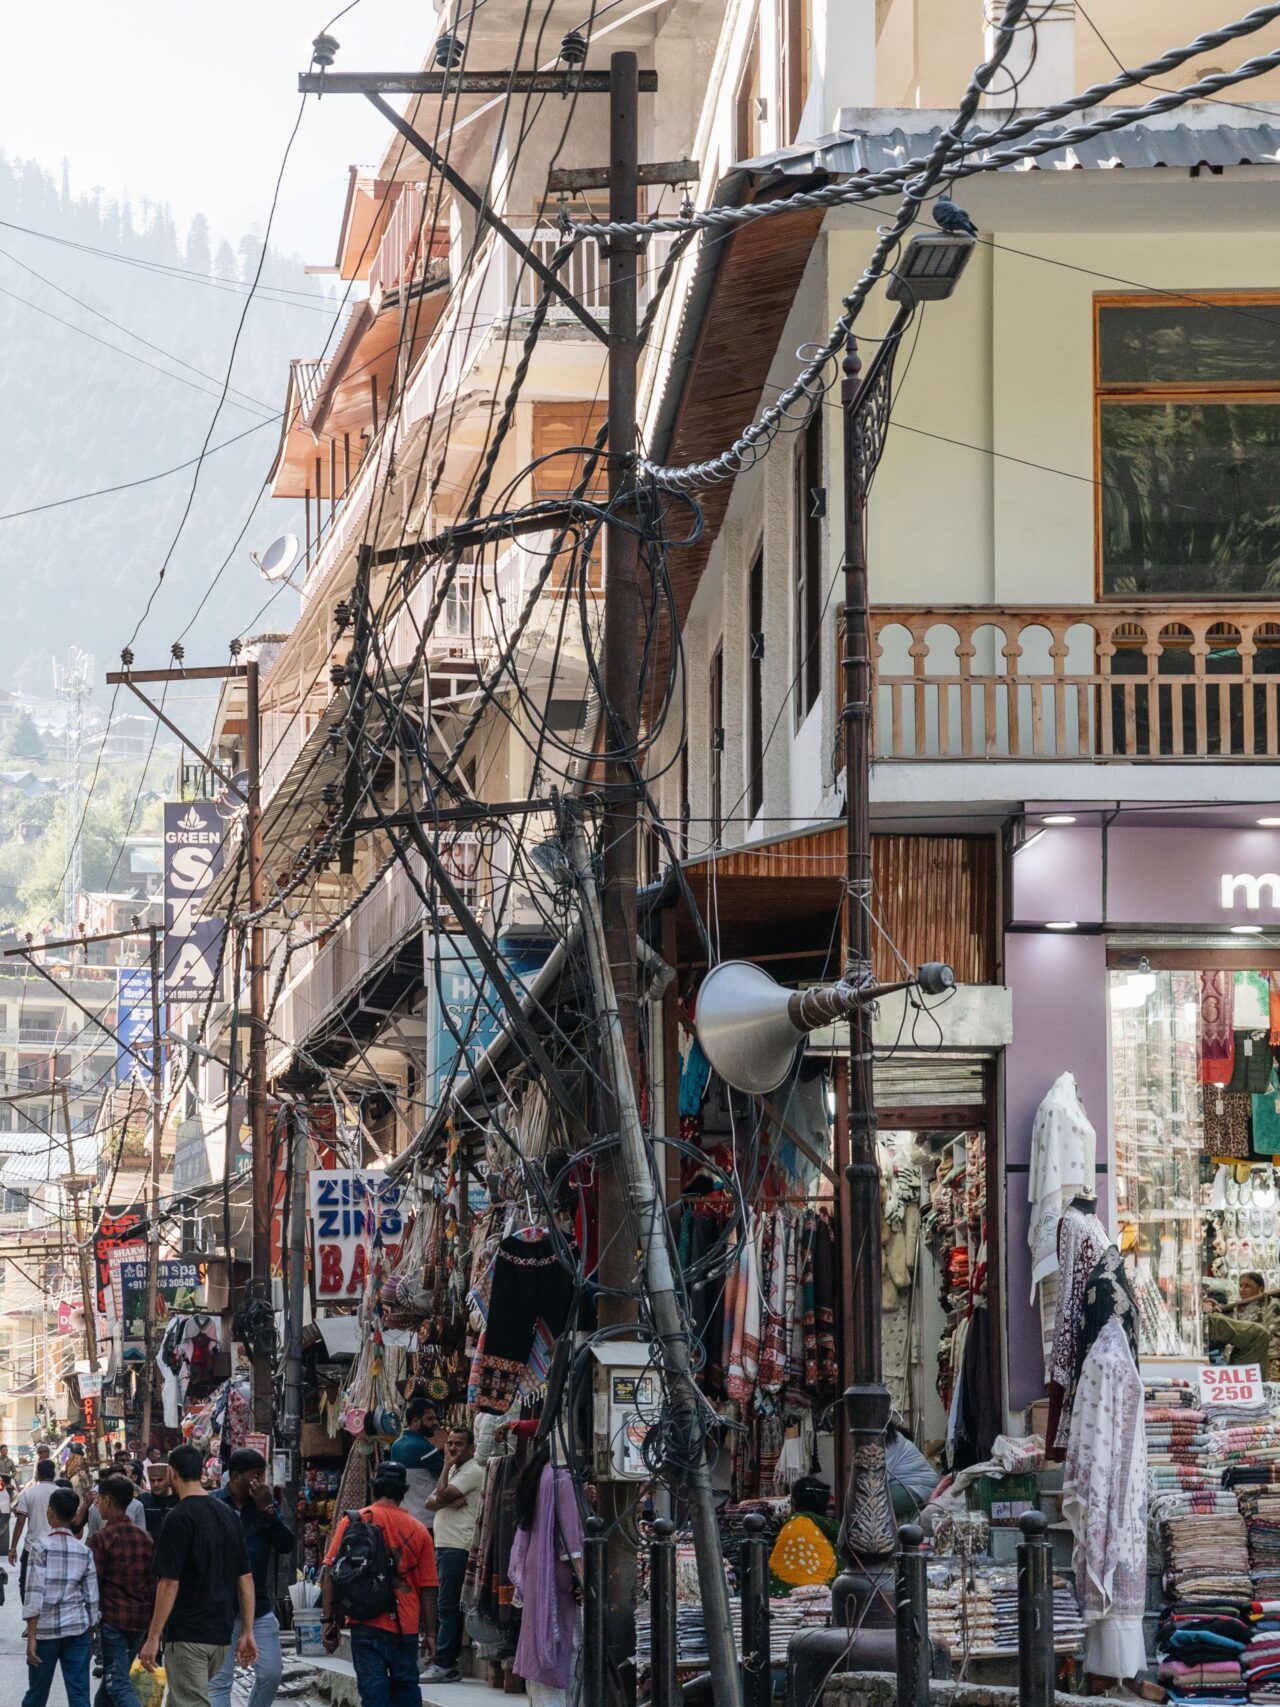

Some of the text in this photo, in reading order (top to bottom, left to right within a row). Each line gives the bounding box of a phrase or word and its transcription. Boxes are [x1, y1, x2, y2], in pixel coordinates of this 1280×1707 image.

[165, 831, 221, 844] GREEN
[165, 846, 220, 988] SPA
[318, 1178, 401, 1206] ZING
[318, 1208, 402, 1237] ZING
[171, 1264, 197, 1278] spa
[1202, 1367, 1258, 1385] SALE
[1211, 1385, 1253, 1401] 250
